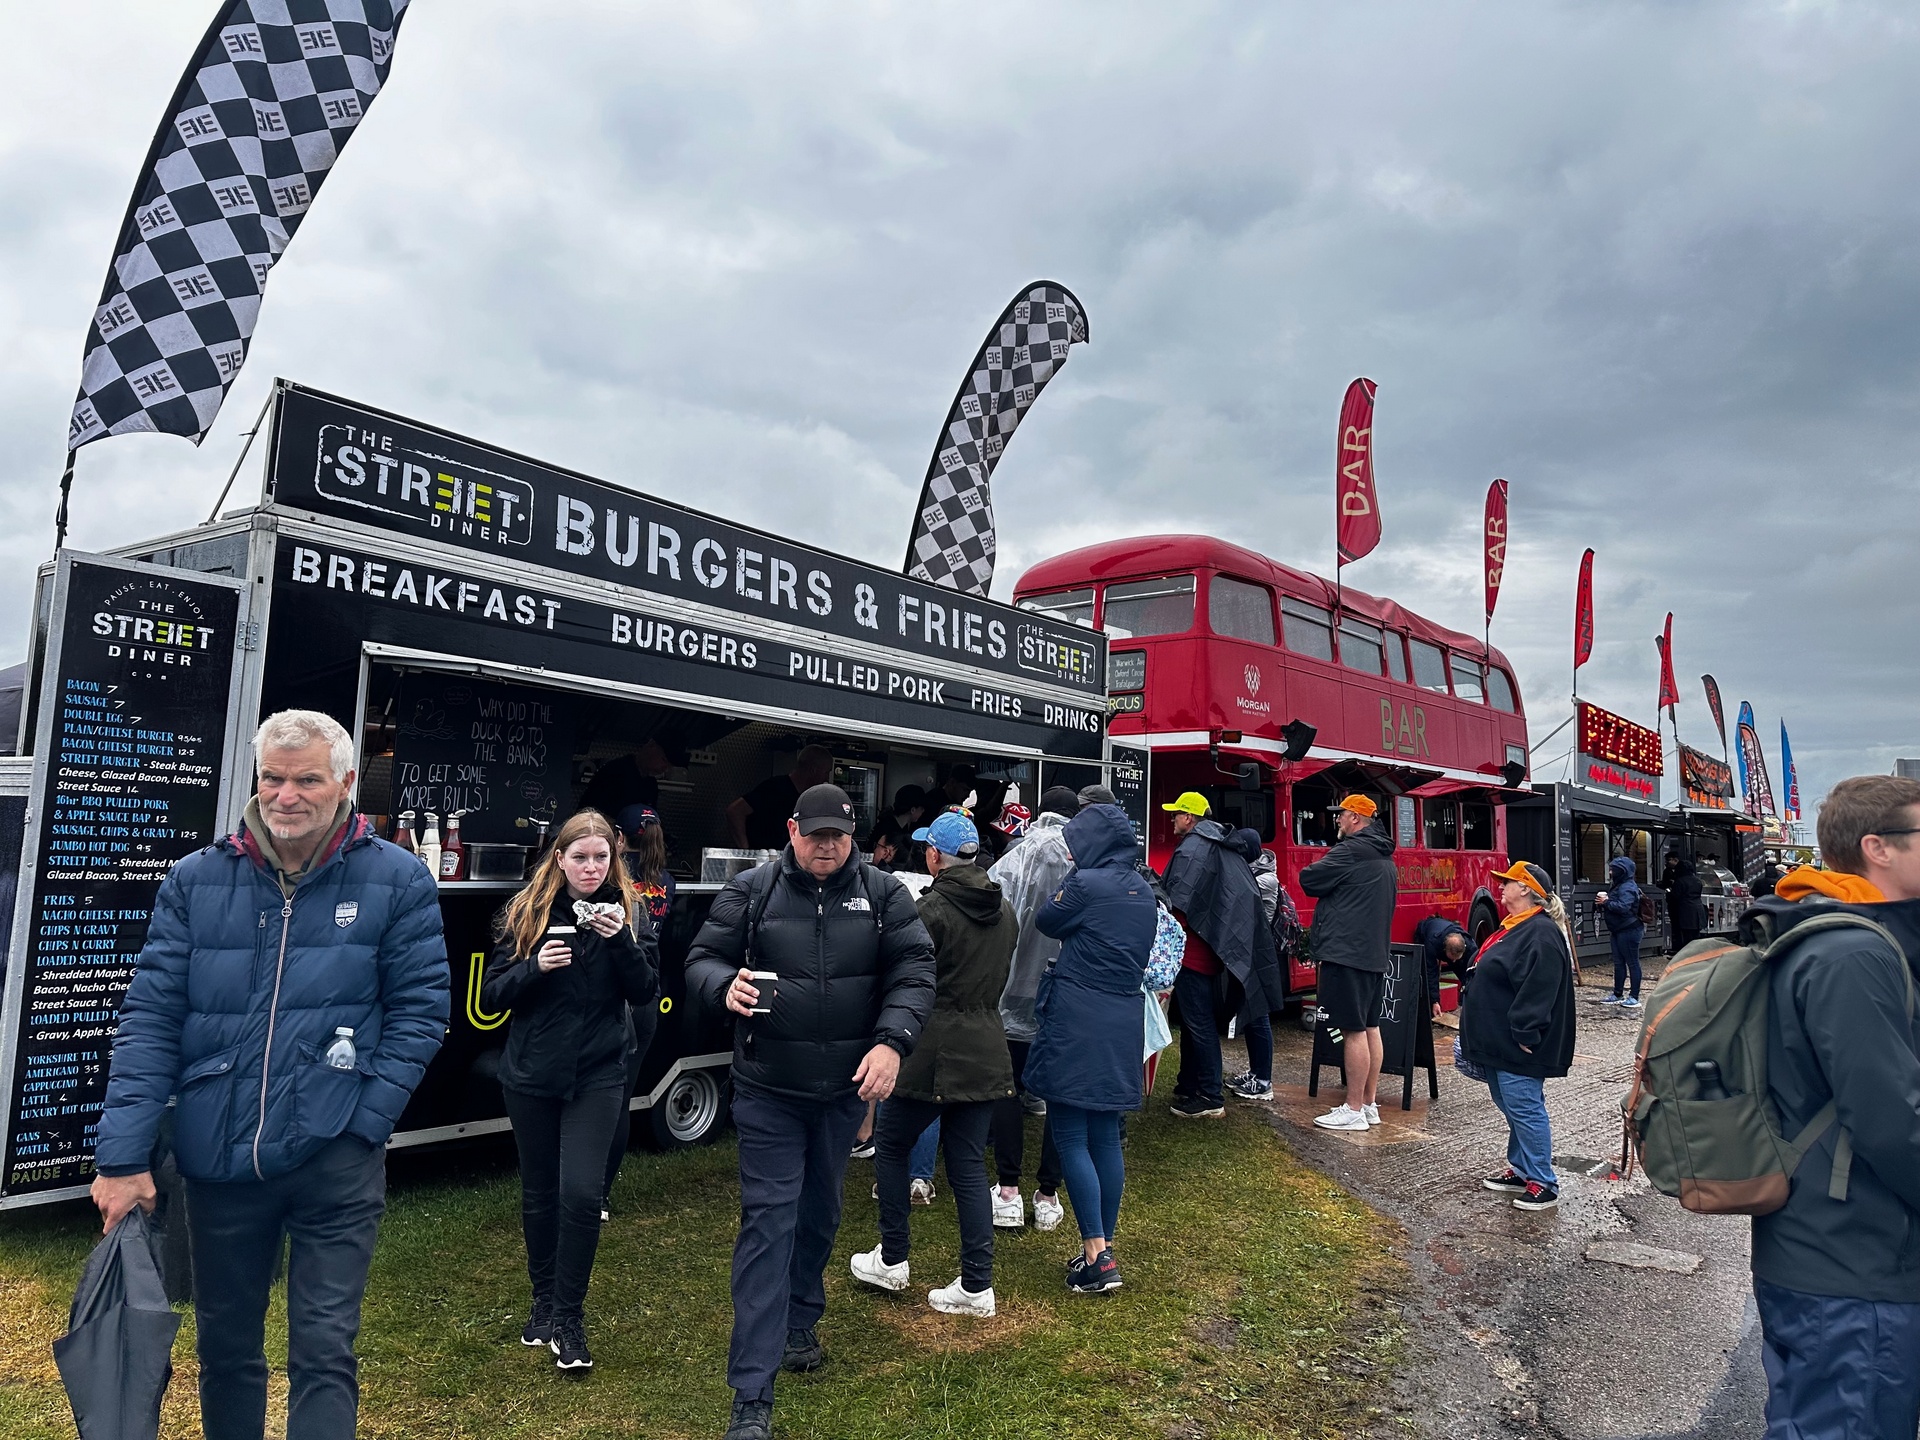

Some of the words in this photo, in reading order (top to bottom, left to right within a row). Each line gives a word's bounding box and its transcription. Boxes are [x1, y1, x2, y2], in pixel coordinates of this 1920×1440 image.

[345, 424, 393, 452] THE
[334, 445, 520, 529] STREET
[431, 513, 508, 545] DINER
[1488, 516, 1505, 588] BAR
[556, 494, 832, 616] BURGERS
[854, 582, 879, 630] &
[899, 593, 1008, 659] FRIES
[104, 582, 135, 605] PAUSE
[150, 581, 170, 590] EAT
[178, 591, 204, 620] ENJOY
[139, 600, 174, 613] THE
[92, 612, 214, 649] STREET
[1026, 624, 1044, 637] THE
[292, 546, 562, 630] BREAKFAST
[612, 613, 757, 668] BURGERS
[788, 651, 879, 691] PULLED
[887, 670, 946, 705] PORK
[971, 688, 1022, 718] FRIES
[1044, 703, 1098, 732] DRINKS
[108, 645, 192, 666] DINER
[1024, 636, 1090, 674] STREET
[1058, 670, 1086, 684] DINER
[67, 679, 100, 692] BACON
[107, 685, 118, 694] 7
[65, 694, 108, 708] SAUSAGE
[114, 700, 126, 709] 7
[1236, 696, 1270, 712] MORGAN
[64, 708, 104, 722] DOUBLE
[106, 713, 124, 724] EGG
[478, 697, 503, 718] WHY
[508, 702, 526, 723] DID
[531, 702, 553, 724] THE
[471, 722, 503, 744] DUCK
[508, 726, 524, 742] GO
[528, 726, 544, 745] TO
[1380, 698, 1430, 757] BAR
[137, 730, 174, 742] BURGER
[62, 738, 94, 750] BACON
[98, 742, 134, 753] CHEESE
[136, 744, 174, 756] BURGER
[474, 742, 496, 762] THE
[506, 744, 546, 767] BANK?
[60, 753, 100, 765] STREET
[102, 756, 140, 768] BURGER
[150, 760, 177, 770] Steak
[179, 762, 212, 774] Burger,
[58, 768, 98, 779] Cheese,
[102, 770, 135, 781] Glazed
[138, 773, 170, 784] Bacon,
[173, 775, 210, 787] Iceberg,
[400, 762, 420, 784] TO
[428, 764, 452, 783] GET
[456, 764, 487, 785] SOME
[56, 781, 89, 792] Street
[91, 783, 122, 793] Sauce
[82, 796, 102, 808] BBQ
[106, 797, 140, 808] PULLED
[144, 800, 170, 810] PORK
[399, 786, 437, 810] MORE
[443, 786, 490, 812] BILLS!
[54, 810, 63, 820] &
[66, 810, 96, 821] APPLE
[98, 812, 130, 822] SAUCE
[132, 813, 150, 823] BAP
[52, 824, 98, 836] SAUSAGE,
[100, 826, 129, 837] CHIPS
[132, 828, 140, 837] &
[143, 828, 176, 838] GRAVY
[50, 840, 86, 852] JUMBO
[89, 842, 108, 852] HOT
[110, 842, 130, 852] DOG
[48, 856, 88, 866] STREET
[90, 856, 110, 866] DOG
[119, 858, 166, 868] Shredded
[47, 870, 84, 880] Glazed
[85, 871, 120, 882] Bacon,
[122, 872, 152, 880] Street
[44, 895, 75, 906] FRIES
[84, 896, 94, 905] 5
[42, 910, 76, 920] NACHO
[79, 910, 116, 920] CHEESE
[118, 910, 148, 920] FRIES
[40, 925, 70, 936] CHIPS
[74, 925, 81, 935] N
[84, 924, 119, 935] GRAVY
[38, 940, 68, 951] CHIPS
[72, 940, 80, 950] N
[82, 939, 117, 950] CURRY
[36, 956, 76, 966] LOADED
[79, 954, 118, 964] STREET
[120, 954, 140, 964] FRI
[42, 970, 92, 980] Shredded
[94, 968, 128, 978] Maple
[33, 985, 70, 994] Bacon,
[72, 983, 106, 992] Nacho
[31, 1000, 65, 1010] Street
[66, 999, 98, 1008] Sauce
[30, 1013, 70, 1025] LOADED
[73, 1011, 109, 1022] PULLED
[36, 1031, 70, 1040] Gravy,
[72, 1028, 104, 1038] Apple
[28, 1052, 78, 1066] YORKSHIRE
[81, 1051, 98, 1060] TEA
[25, 1066, 78, 1079] AMERICANO
[24, 1079, 78, 1092] CAPPUCCINO
[22, 1094, 50, 1106] LATTE
[20, 1106, 59, 1120] LUXURY
[62, 1104, 78, 1116] HOT
[16, 1132, 40, 1142] CANS
[16, 1144, 50, 1156] WATER
[14, 1161, 36, 1170] FOOD
[37, 1155, 81, 1168] ALLERGIES?
[11, 1166, 61, 1184] PAUSE
